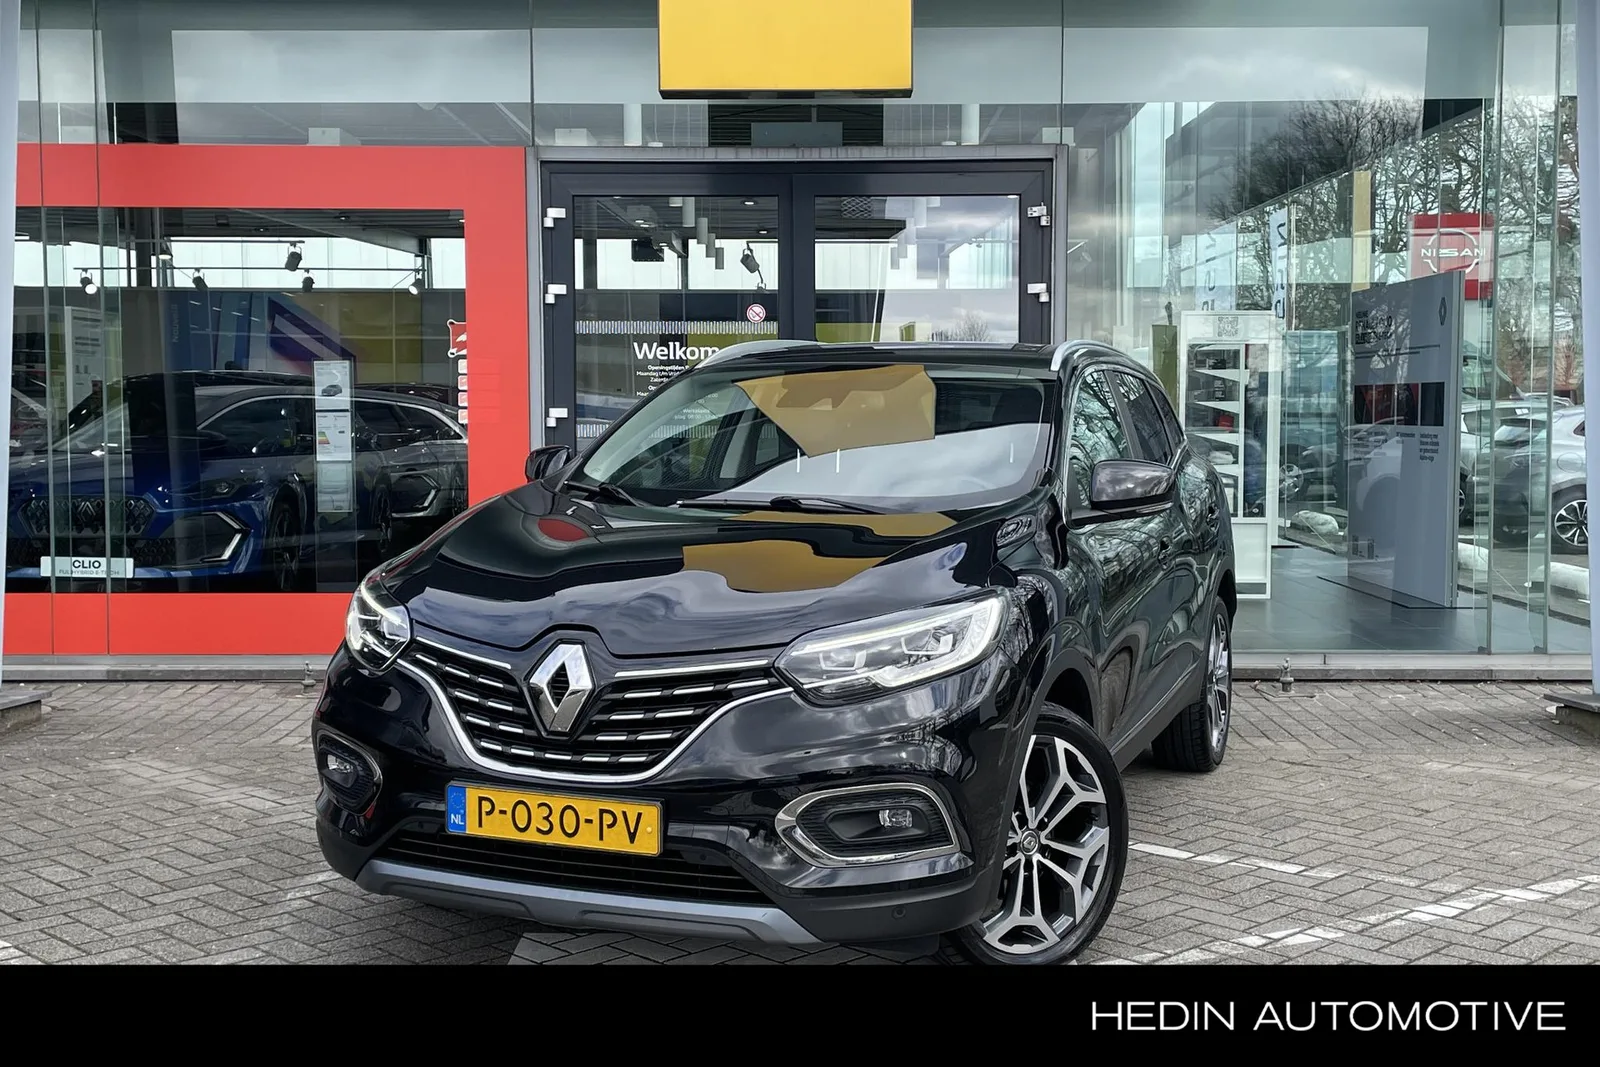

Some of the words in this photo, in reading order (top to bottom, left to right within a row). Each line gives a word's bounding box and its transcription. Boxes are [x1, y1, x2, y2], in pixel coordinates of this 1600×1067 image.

[633, 341, 720, 360] Welkom
[72, 560, 102, 569] CLIO
[451, 813, 465, 825] NL
[477, 795, 643, 845] P-030-PV
